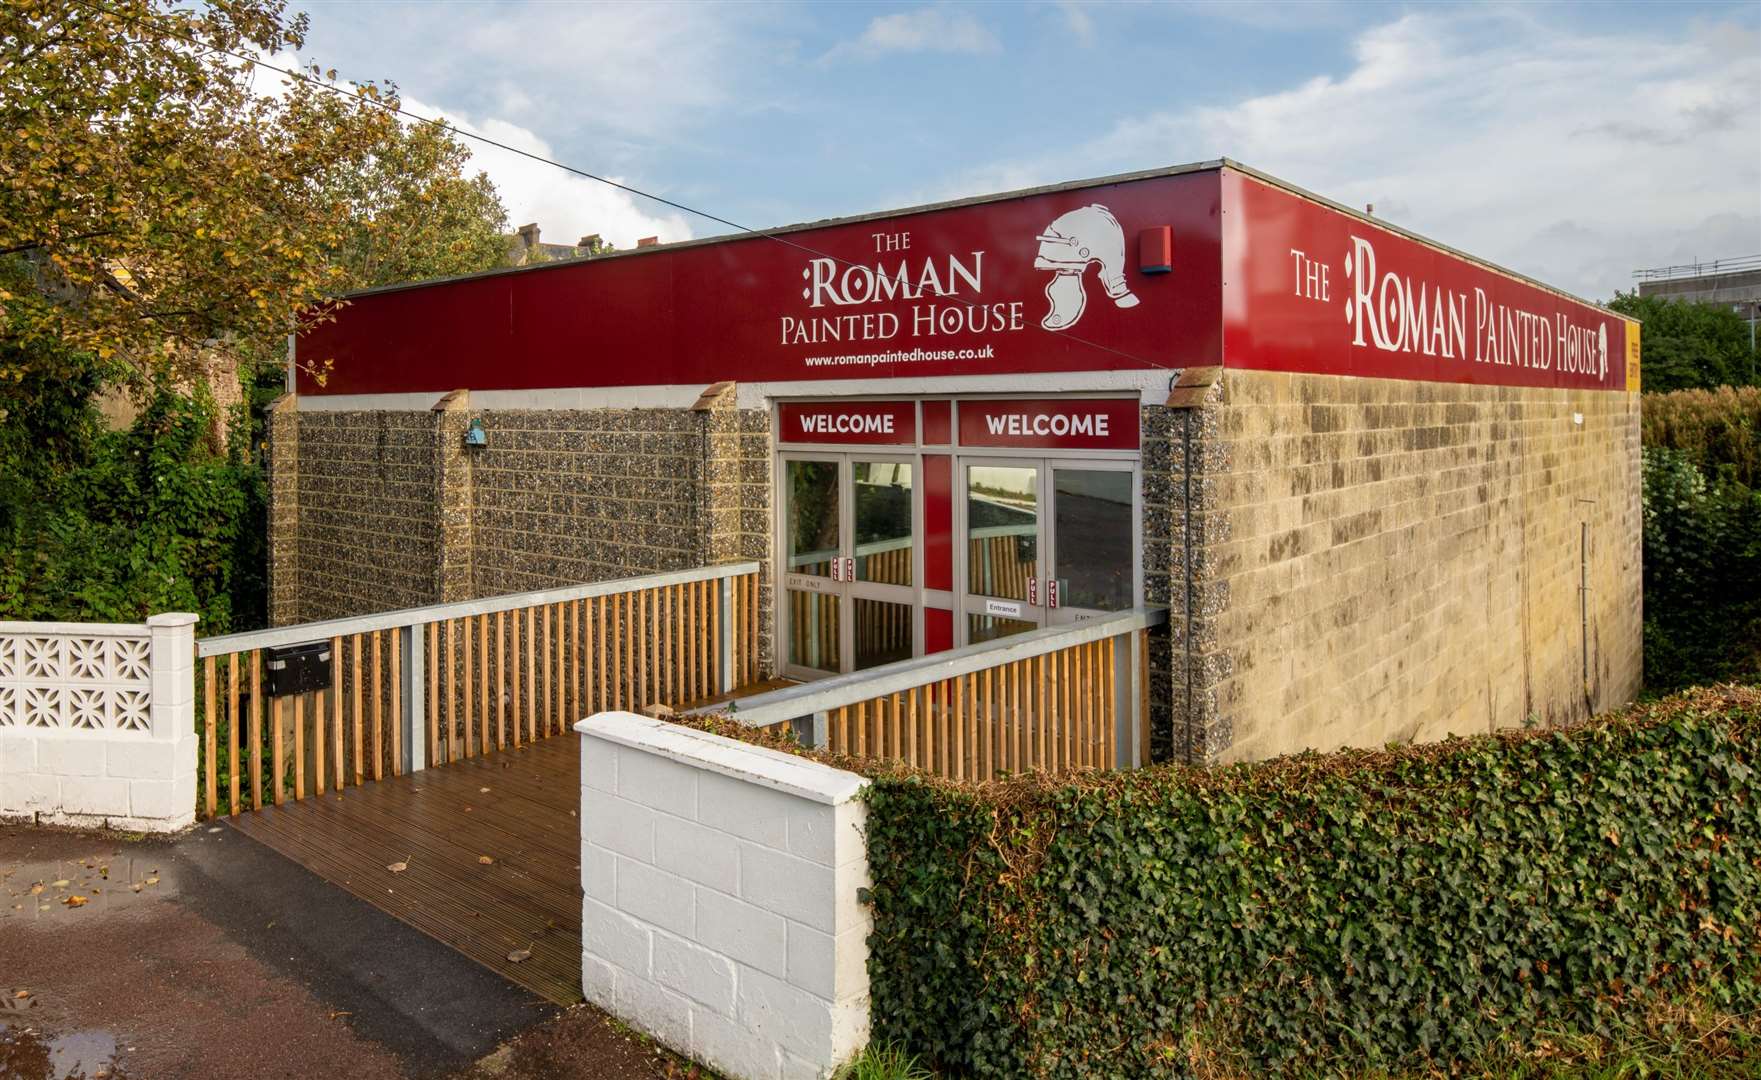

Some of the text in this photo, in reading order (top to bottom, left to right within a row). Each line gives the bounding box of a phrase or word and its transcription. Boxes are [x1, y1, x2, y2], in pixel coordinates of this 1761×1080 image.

[872, 232, 911, 253] THE
[806, 250, 985, 308] ROMAN
[1291, 235, 1598, 375] THE ROMAN PAINTED HOUSE
[781, 302, 1024, 345] PAINTED HOUSE
[805, 344, 994, 368] www.romanpaintedhouse.co.uk
[800, 414, 894, 434] WELCOME
[985, 414, 1109, 435] WELCOME
[989, 604, 1017, 614] Entrance
